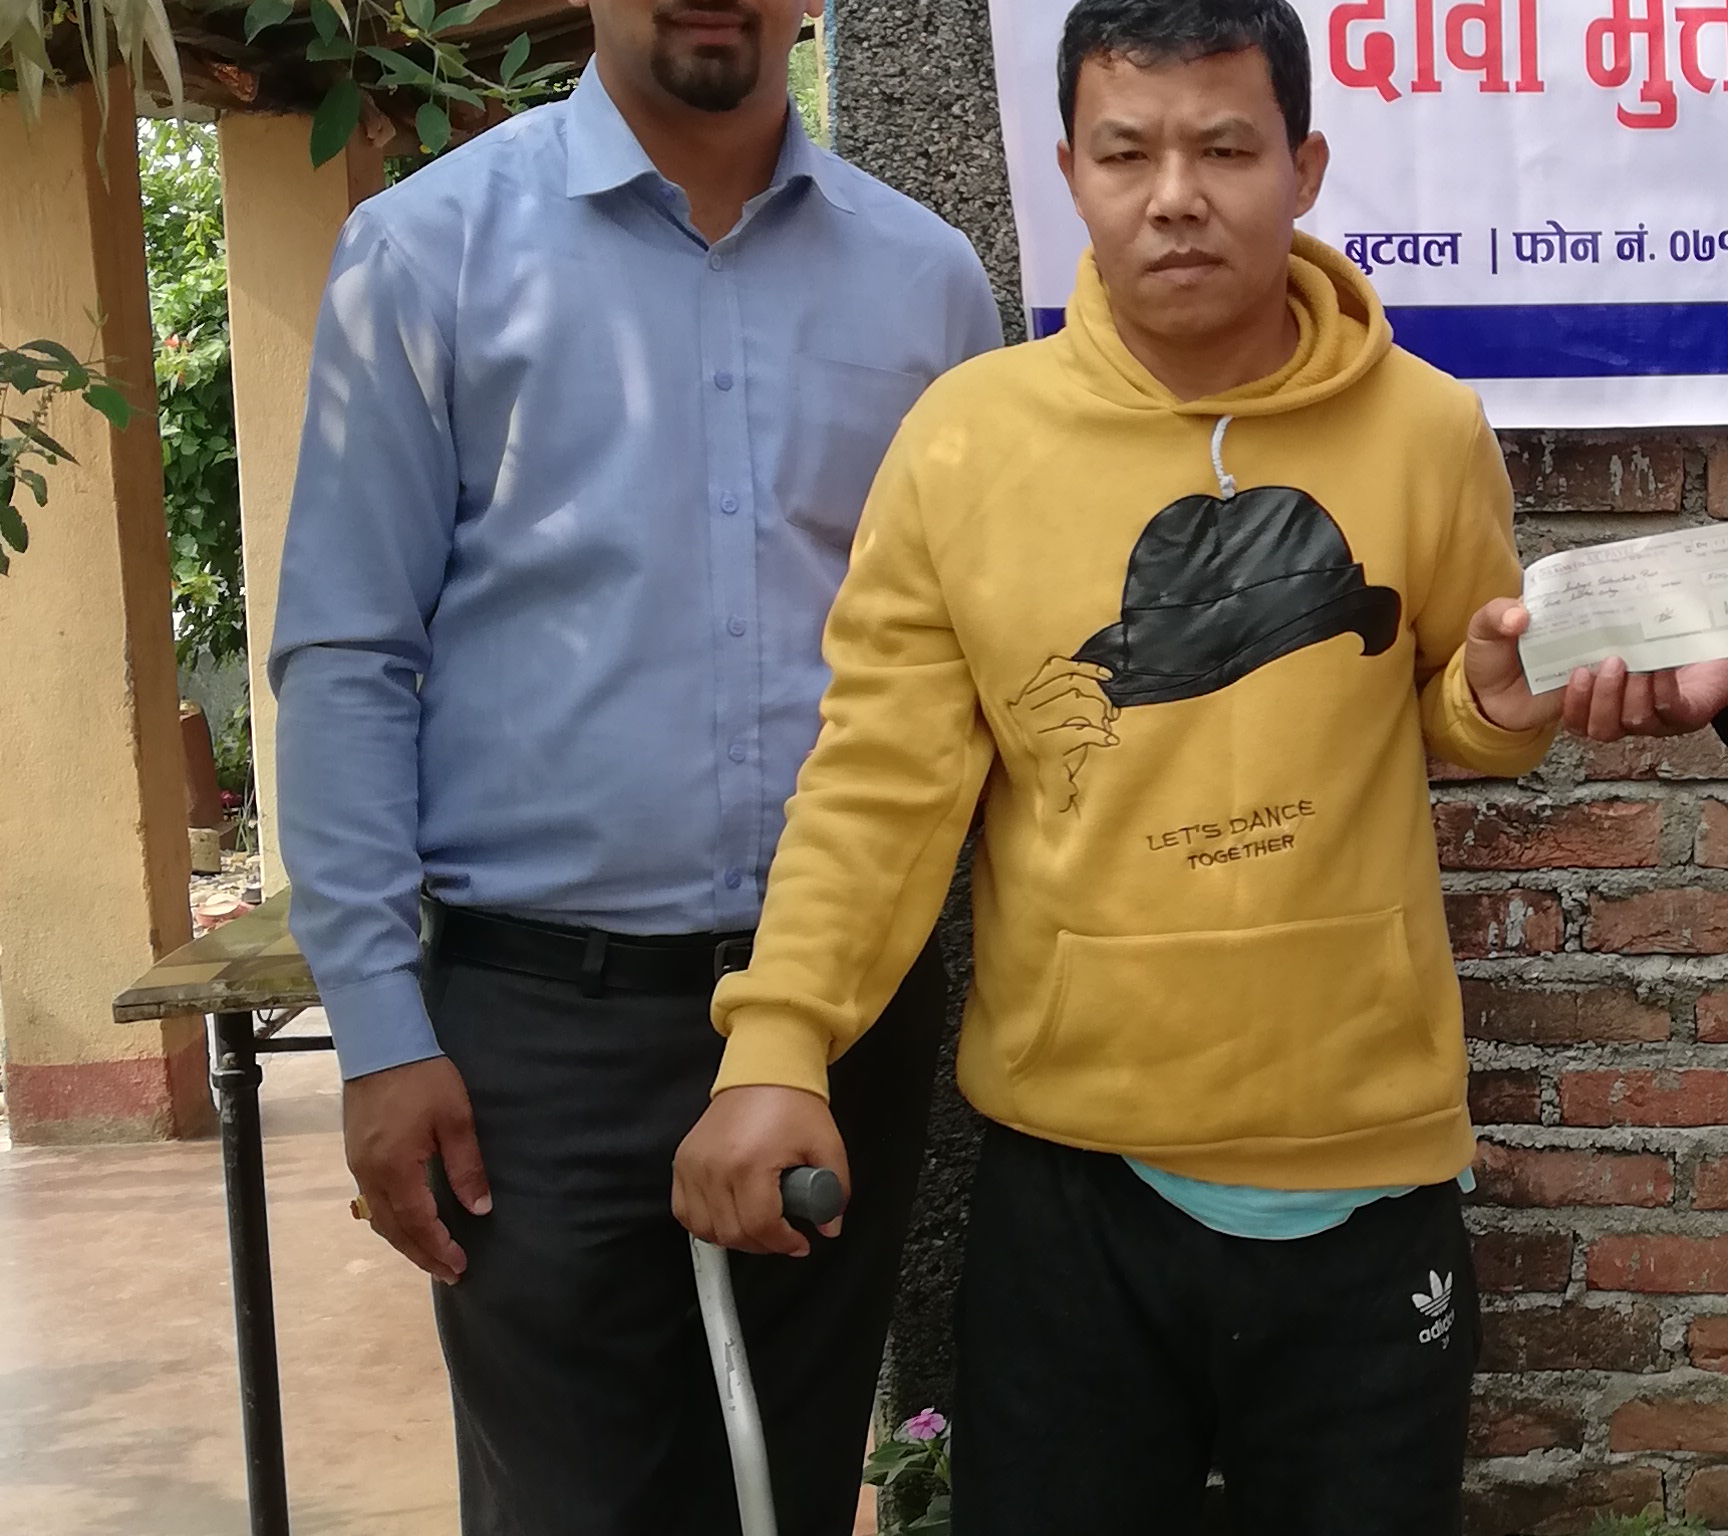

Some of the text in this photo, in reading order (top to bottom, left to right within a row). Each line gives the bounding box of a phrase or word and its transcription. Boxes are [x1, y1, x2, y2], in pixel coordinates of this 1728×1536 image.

[1343, 231, 1463, 277] बुटवल
[1512, 220, 1603, 265] फोन
[1614, 222, 1656, 263] नं.
[1145, 799, 1317, 852] LET'S DANCE
[1185, 833, 1296, 871] TOGETHER
